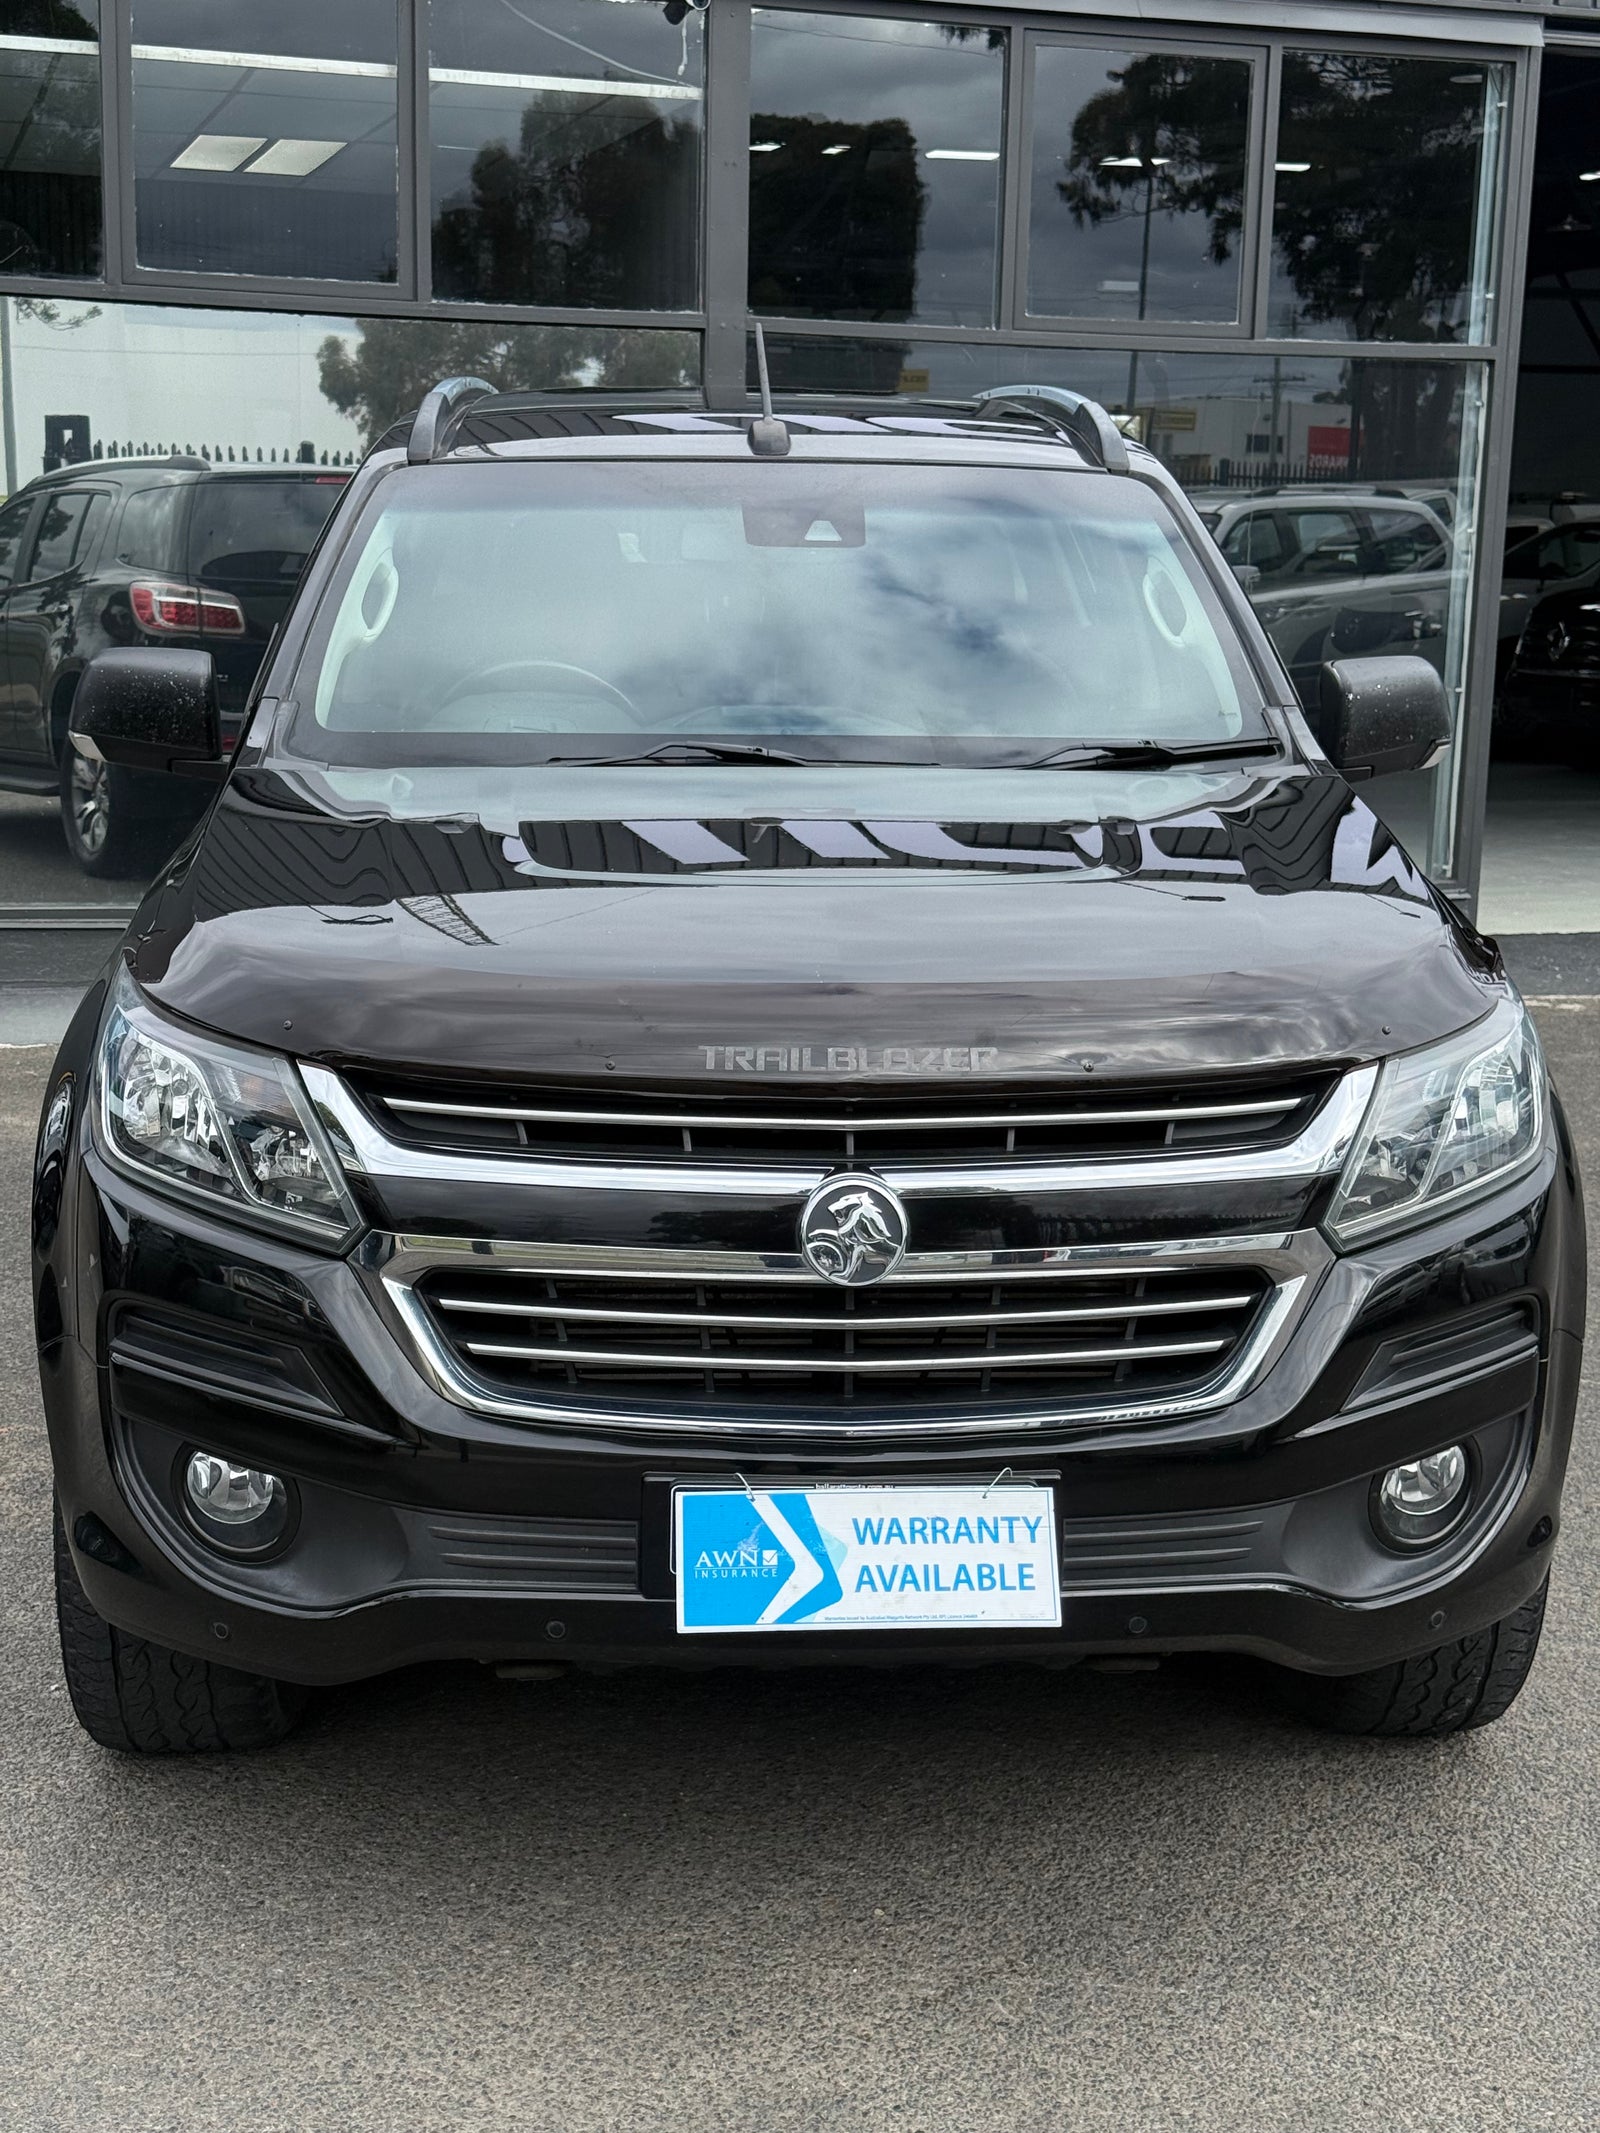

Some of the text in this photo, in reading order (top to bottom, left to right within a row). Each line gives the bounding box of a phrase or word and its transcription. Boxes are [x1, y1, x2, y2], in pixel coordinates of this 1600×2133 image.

[698, 1045, 999, 1072] TRAILBLAZER
[851, 1515, 1043, 1546] WARRANTY
[694, 1550, 758, 1568] AWN
[694, 1568, 778, 1579] INSURANCE
[854, 1563, 1036, 1593] AVAILABLE
